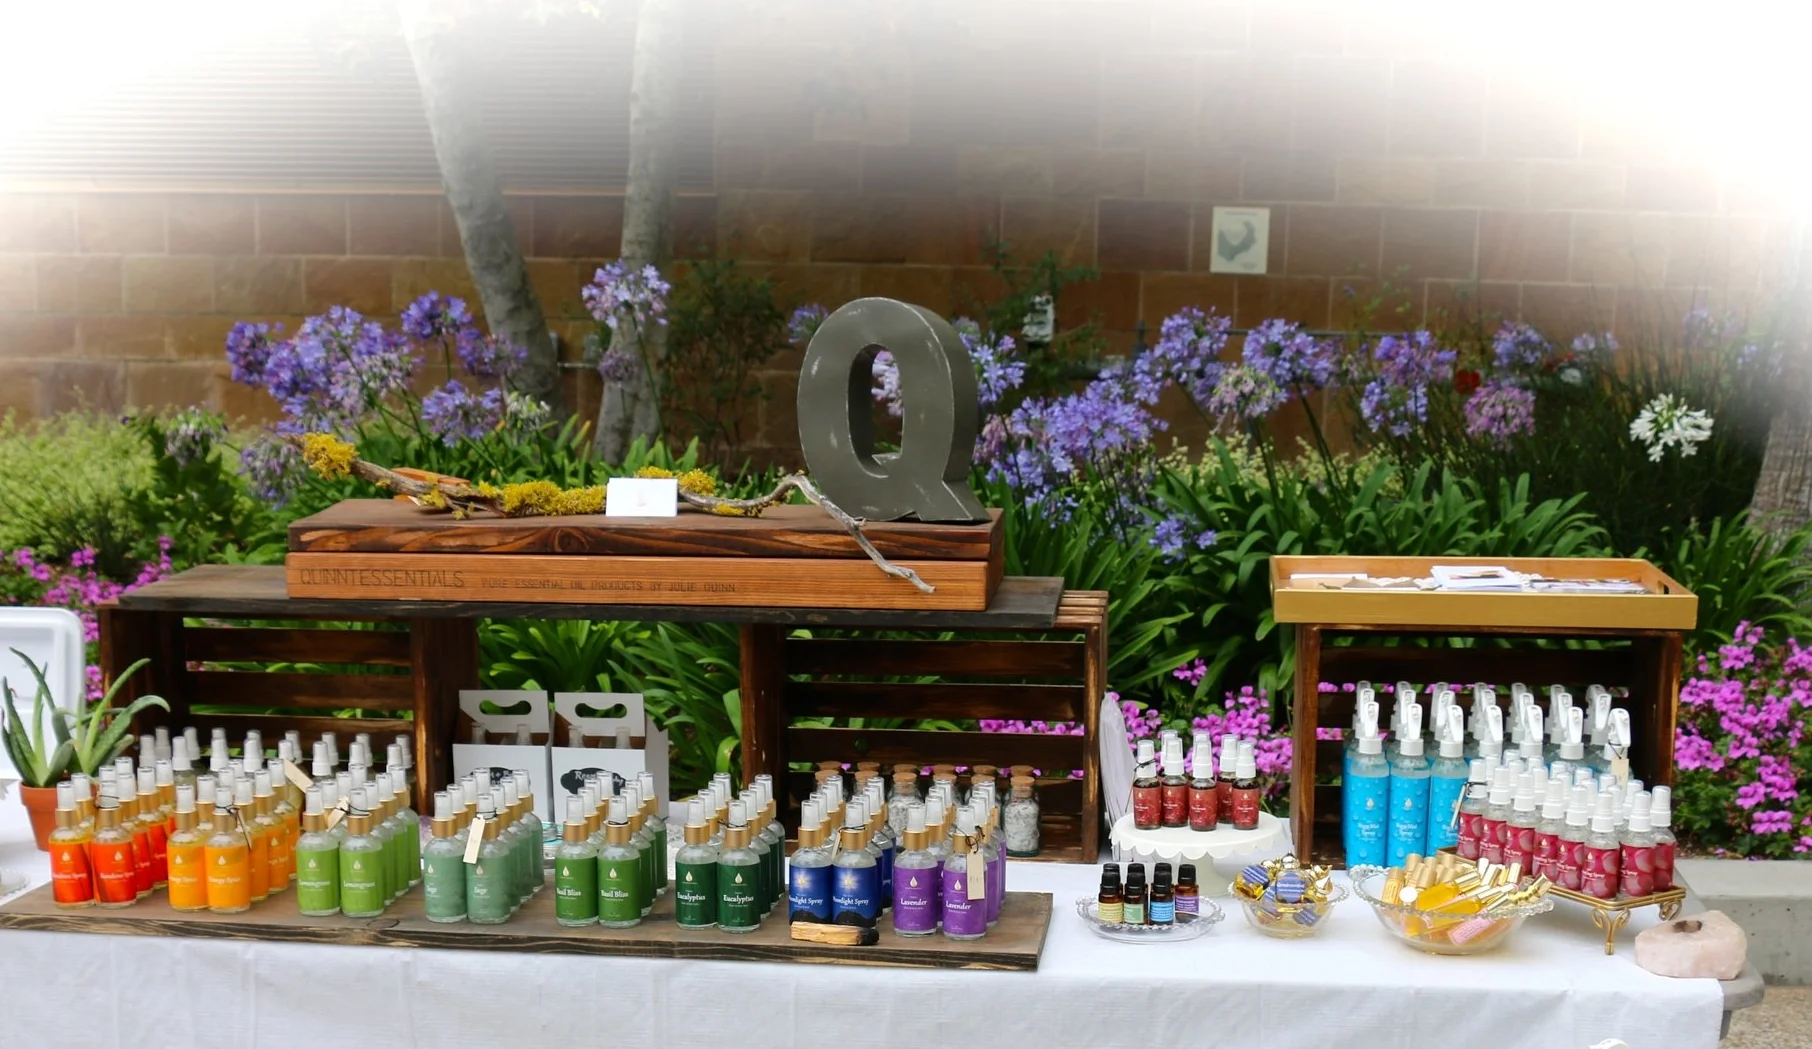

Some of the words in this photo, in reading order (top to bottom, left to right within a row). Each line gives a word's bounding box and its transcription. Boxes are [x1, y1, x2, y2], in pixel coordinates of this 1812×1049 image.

[797, 297, 992, 522] Q
[300, 568, 464, 588] QUINNTESSENTIALS
[515, 579, 567, 589] ESSENTIAL
[570, 580, 586, 590] OIL
[591, 580, 643, 591] PRODUCTS
[669, 581, 696, 592] JULIE
[703, 582, 735, 593] QUINN
[567, 889, 582, 897] Bliss
[614, 890, 629, 898] Bliss
[676, 891, 706, 902] Eucalyptus
[723, 894, 754, 904] Eucalyptus
[808, 898, 823, 906] Spray
[855, 898, 869, 906] Spray
[900, 898, 927, 906] Lavender
[945, 900, 971, 910] Lavender
